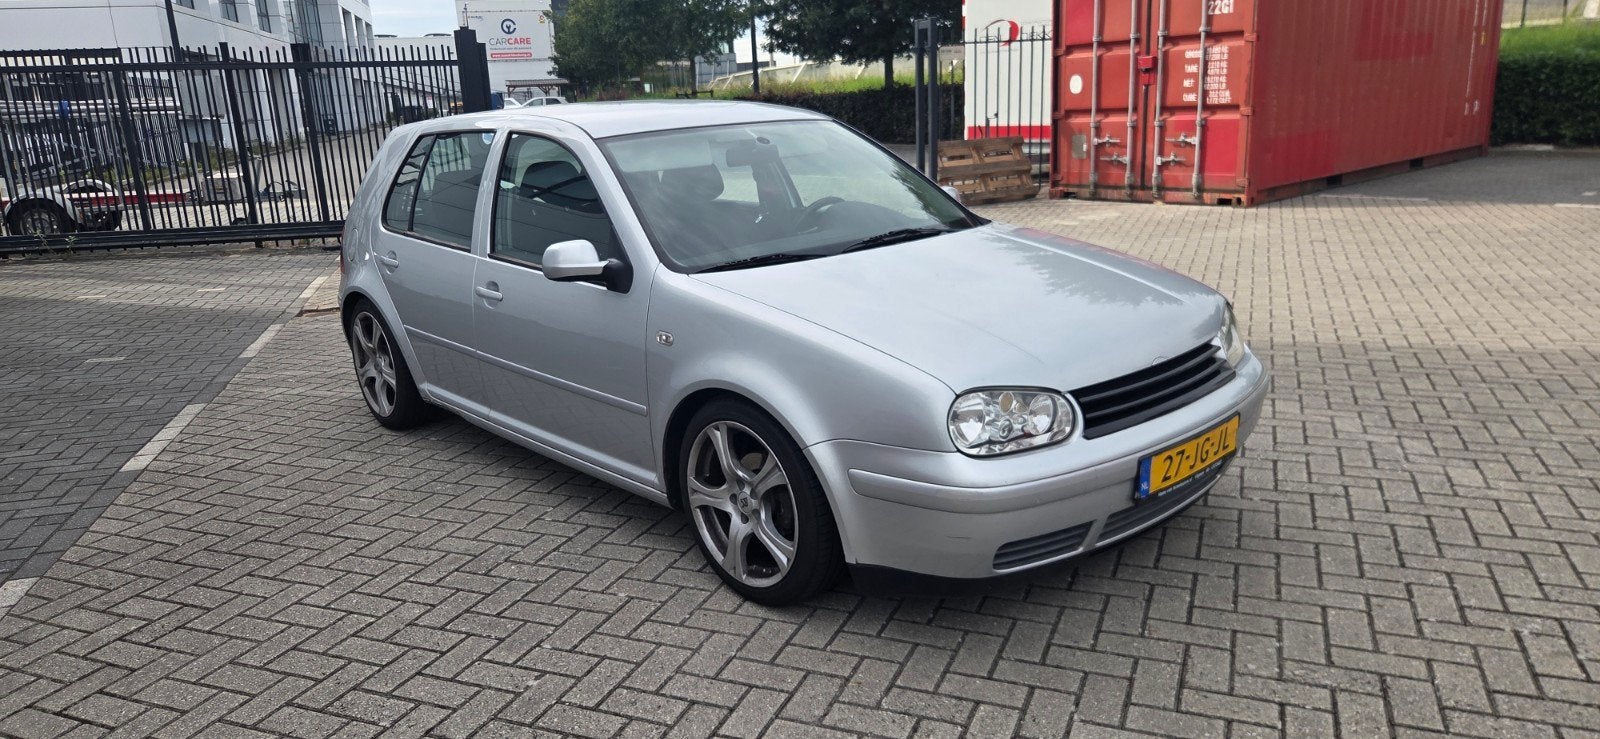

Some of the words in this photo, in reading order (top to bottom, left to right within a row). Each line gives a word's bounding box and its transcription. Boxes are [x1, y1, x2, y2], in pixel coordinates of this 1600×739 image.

[1208, 0, 1235, 15] 22G1
[489, 37, 532, 46] CARCARE
[1184, 64, 1199, 73] TARE
[1183, 79, 1196, 88] NET
[1161, 427, 1229, 483] 27-JG-JL
[1141, 481, 1149, 491] NL
